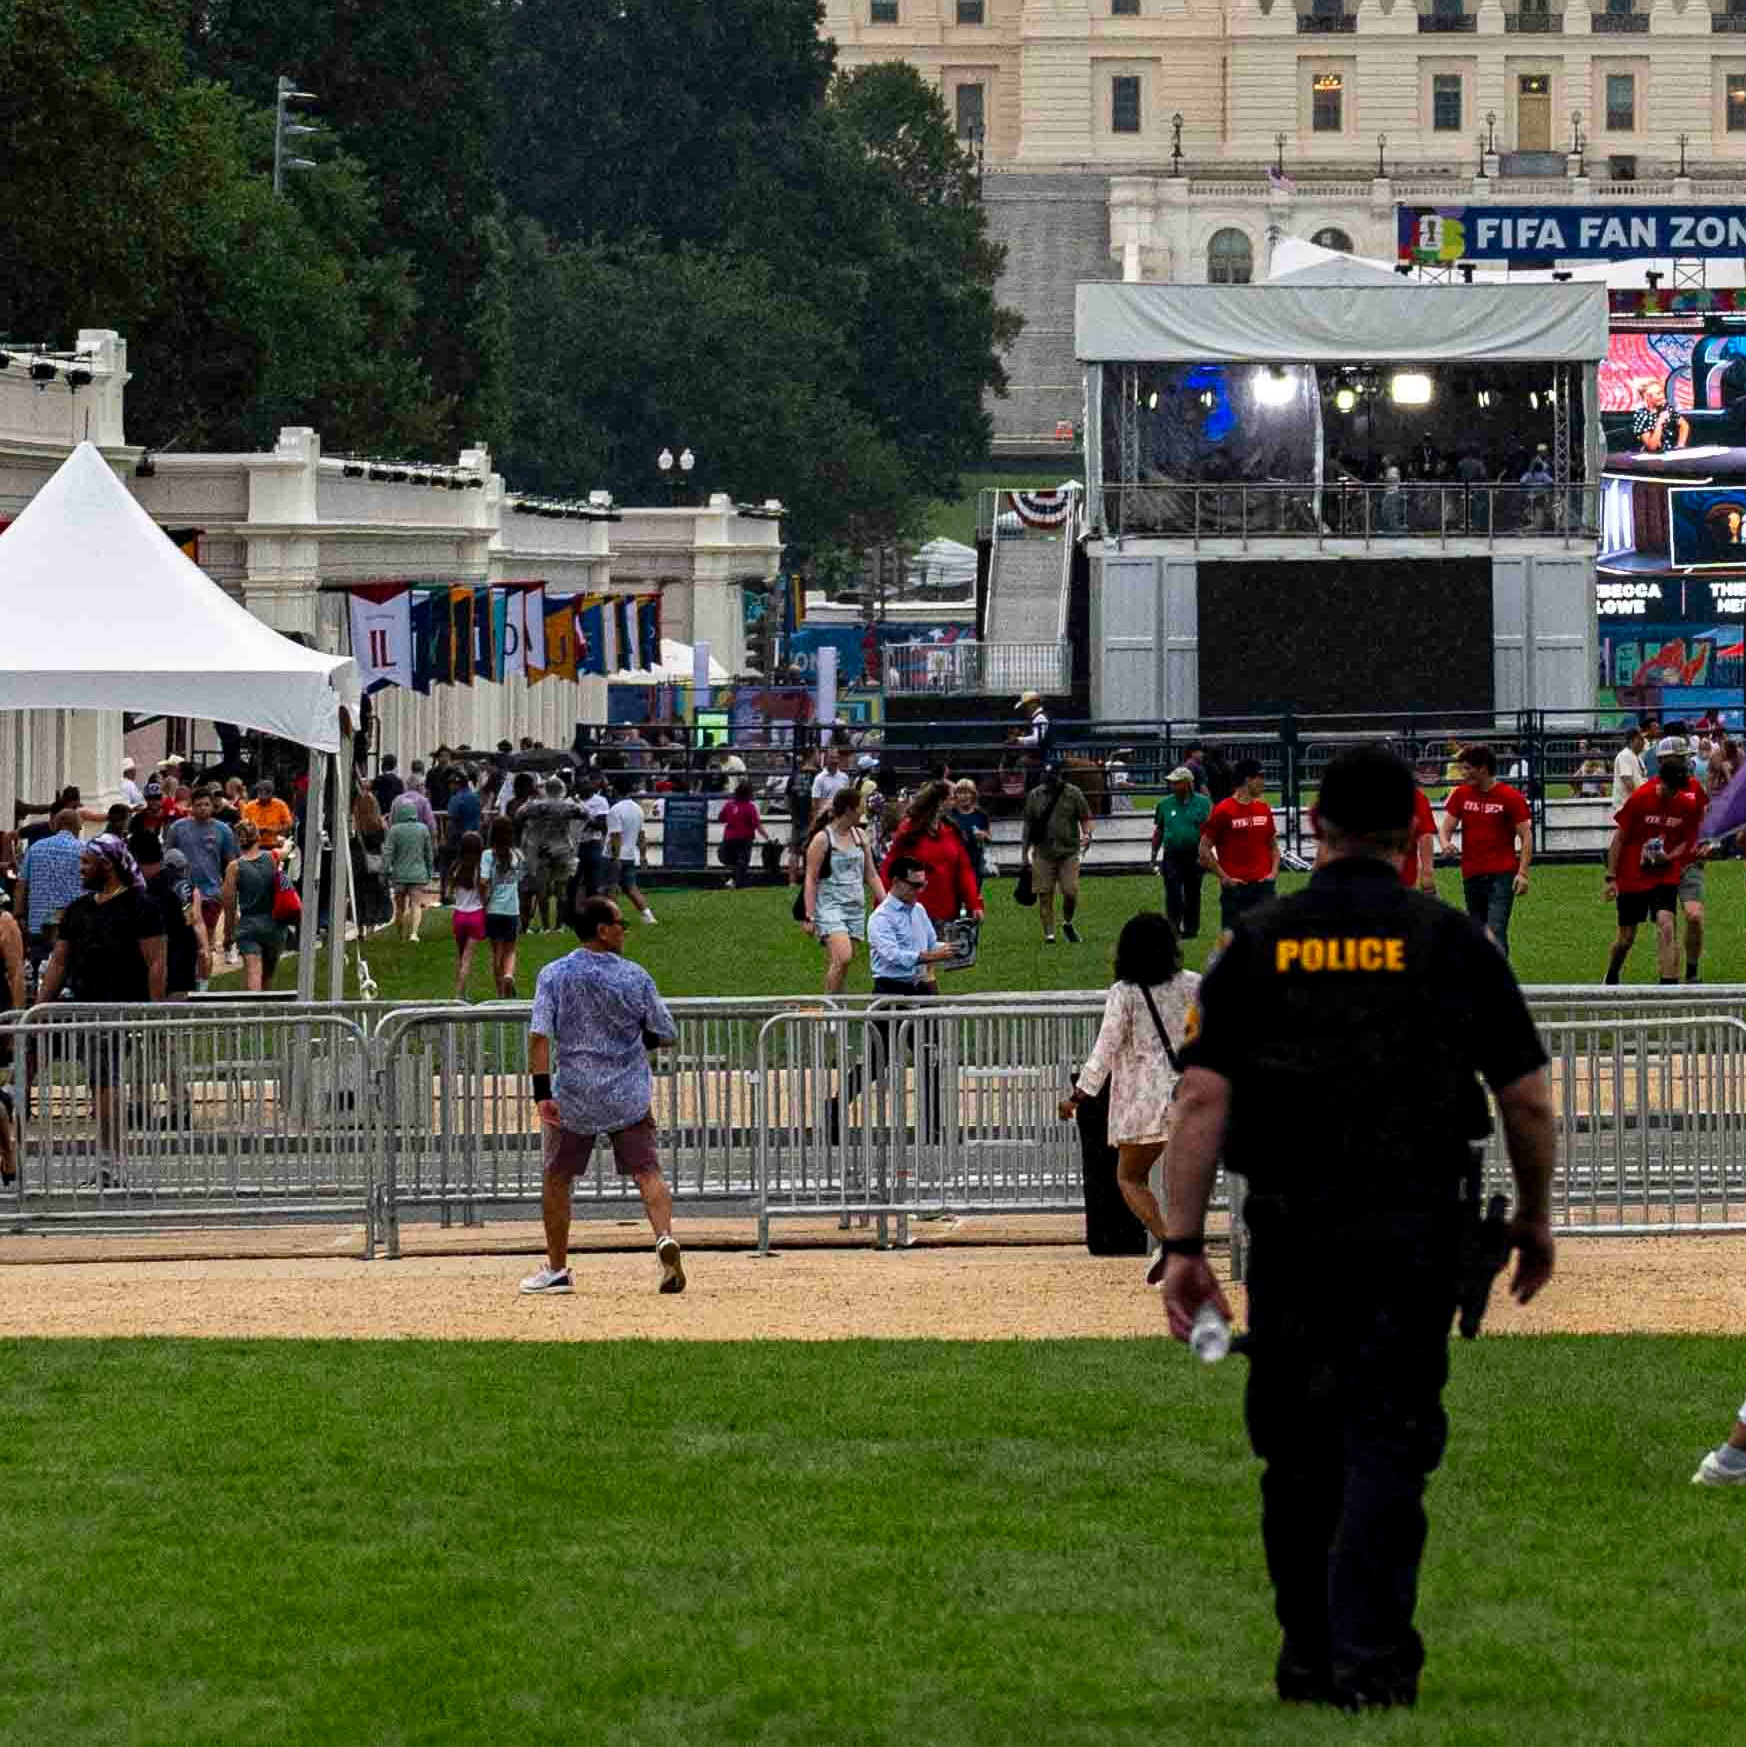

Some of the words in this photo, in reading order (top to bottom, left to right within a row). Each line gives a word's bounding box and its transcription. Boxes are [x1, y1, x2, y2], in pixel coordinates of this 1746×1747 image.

[1476, 217, 1566, 250] FIFA
[1579, 216, 1657, 249] FAN
[368, 629, 397, 669] IL
[1275, 937, 1407, 974] POLICE
